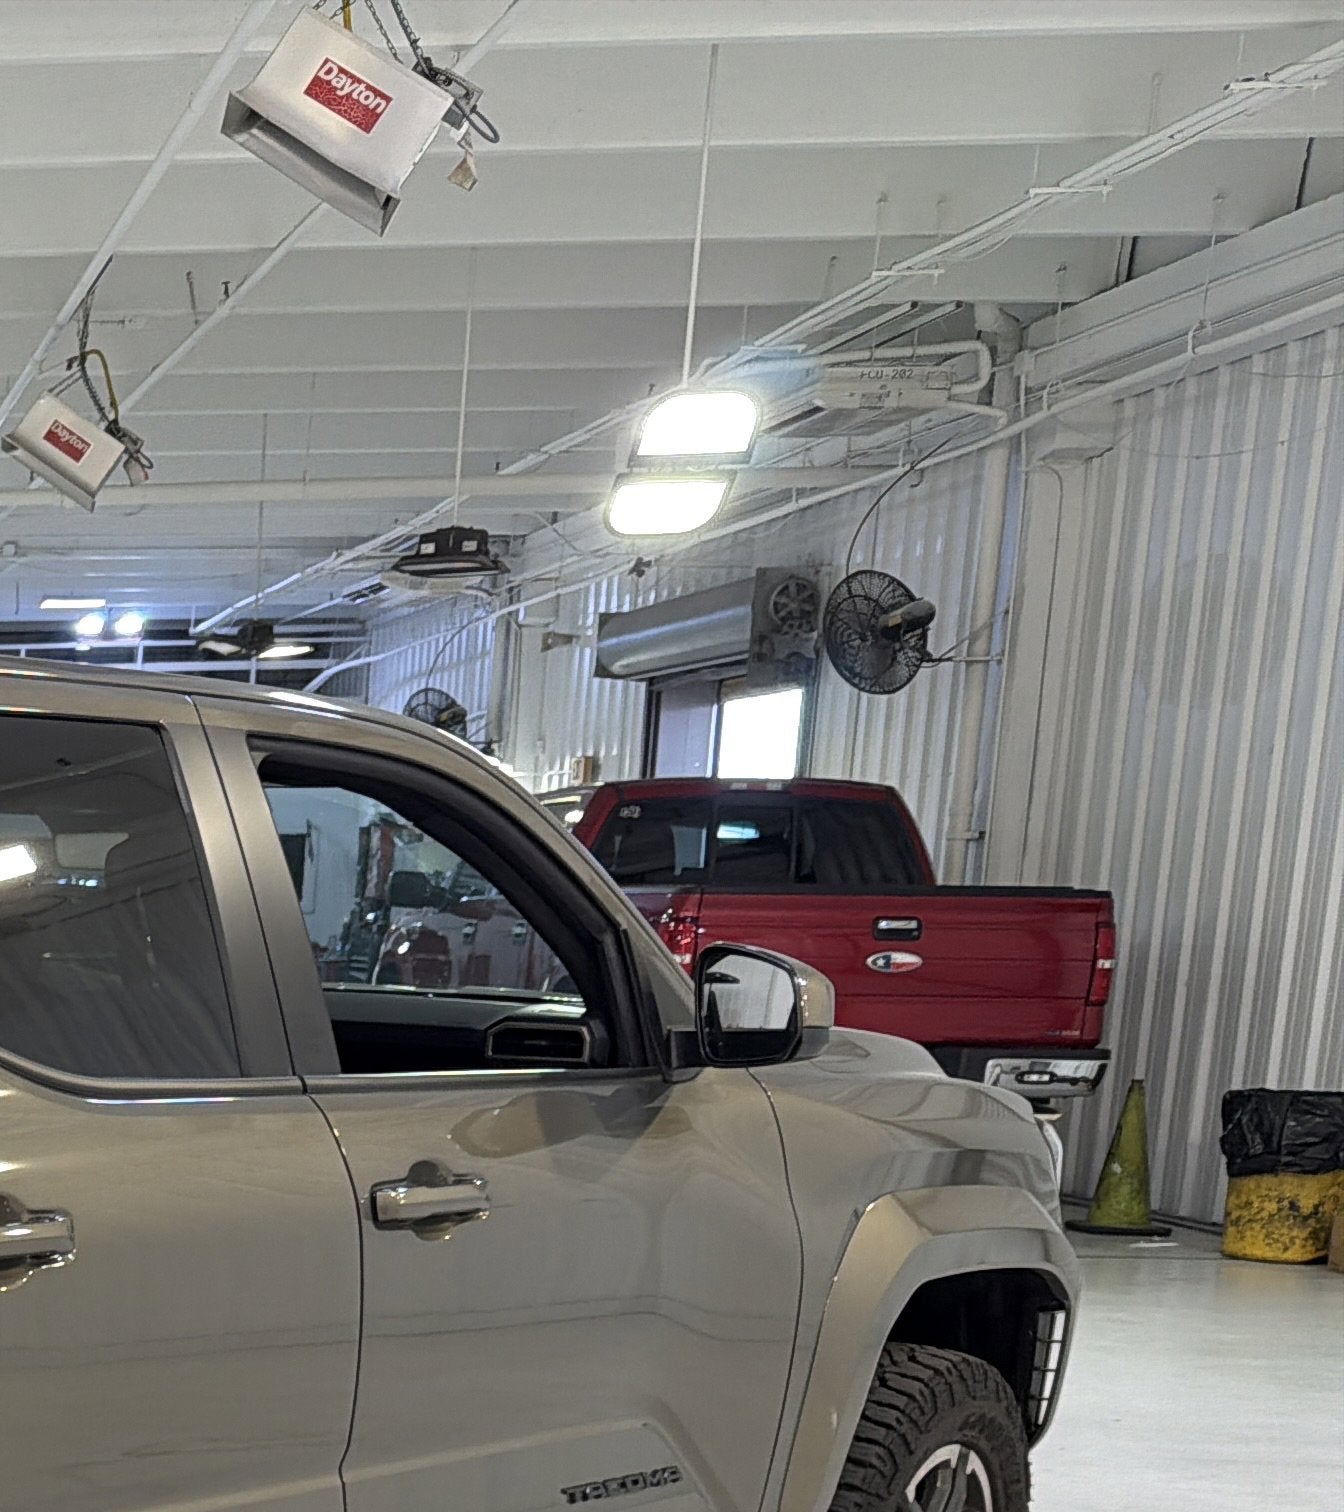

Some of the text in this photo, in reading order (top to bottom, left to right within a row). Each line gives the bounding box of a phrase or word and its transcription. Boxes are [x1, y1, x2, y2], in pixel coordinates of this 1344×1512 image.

[316, 61, 387, 114] Dayton
[51, 422, 89, 453] Dayton
[560, 1465, 683, 1504] TACOMA
